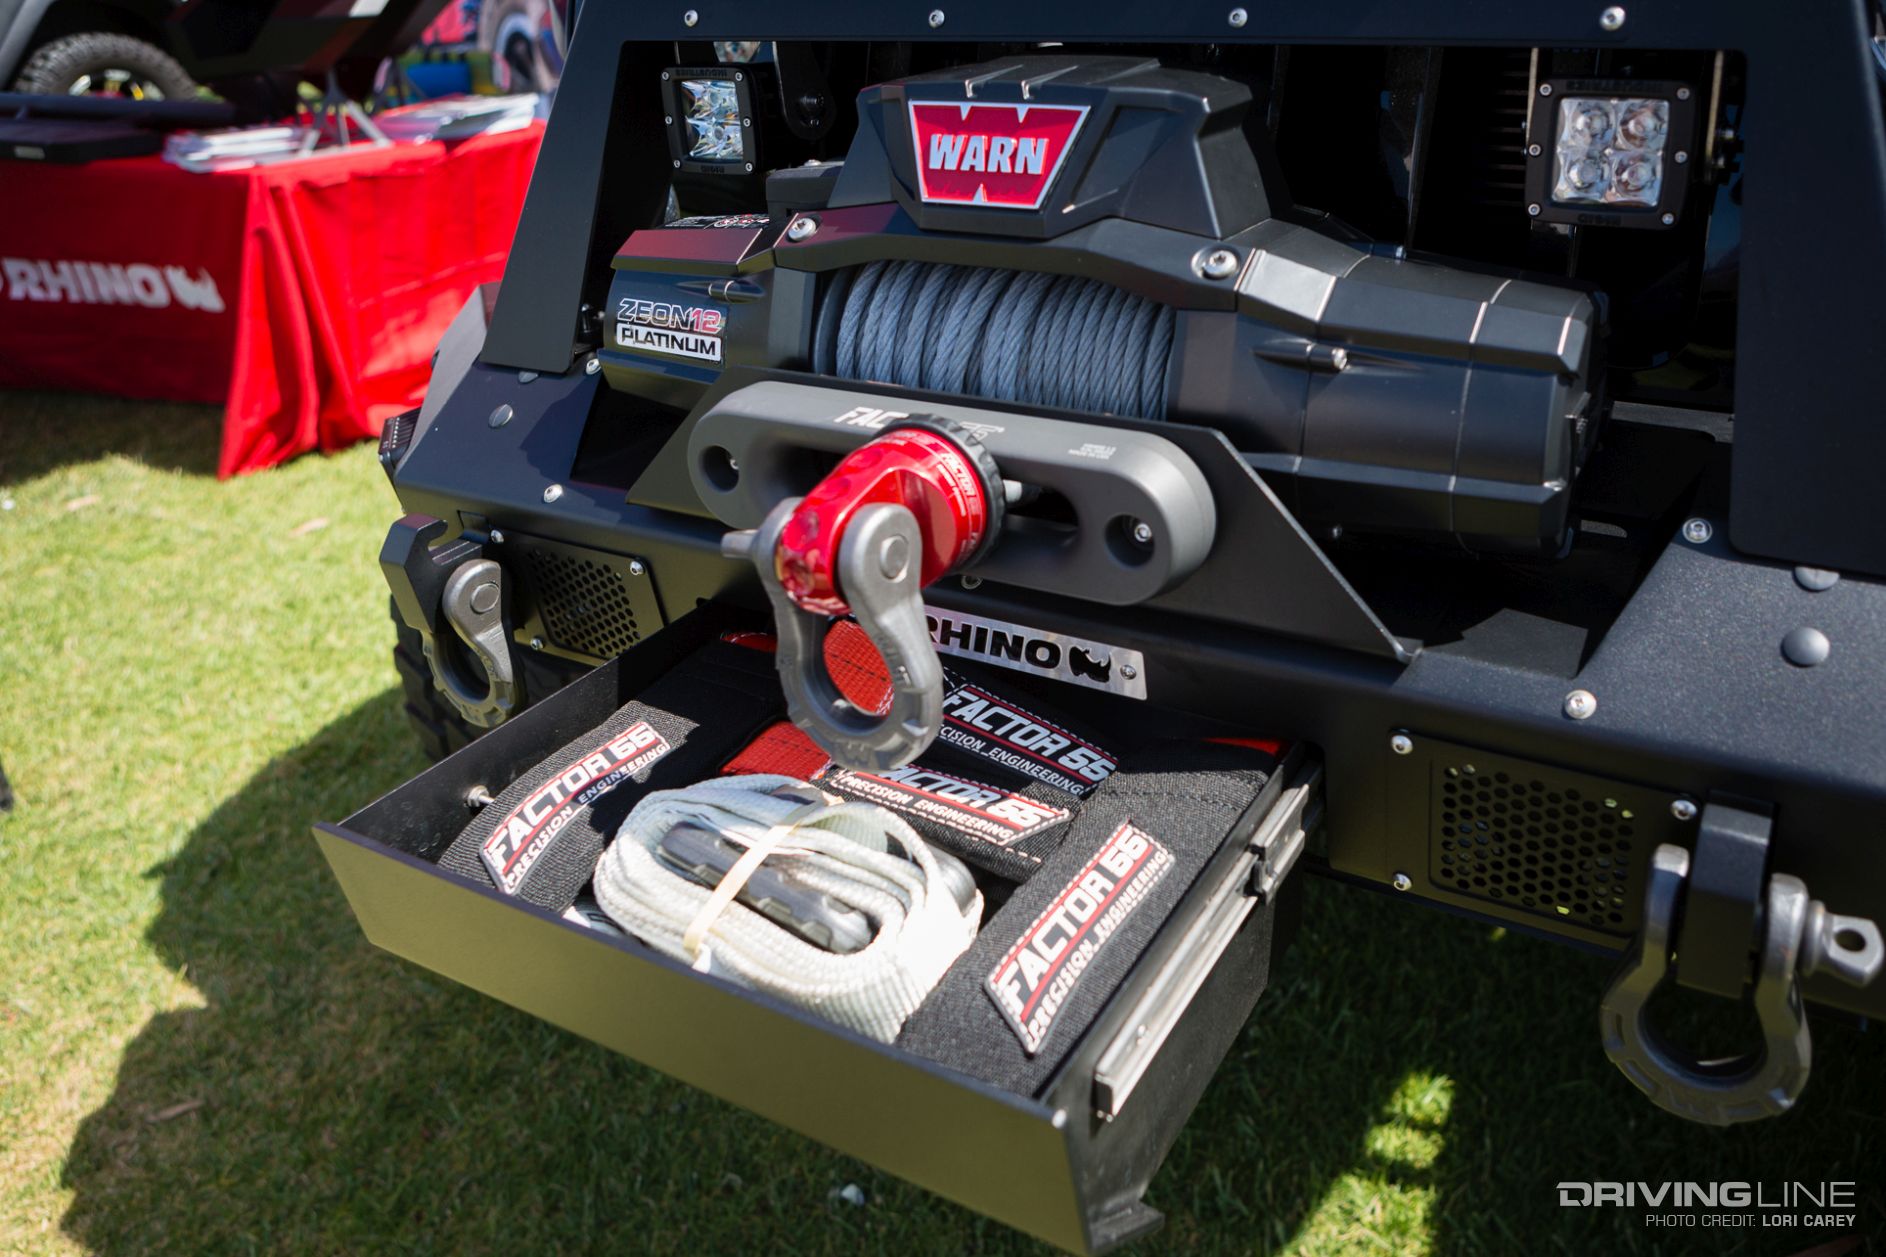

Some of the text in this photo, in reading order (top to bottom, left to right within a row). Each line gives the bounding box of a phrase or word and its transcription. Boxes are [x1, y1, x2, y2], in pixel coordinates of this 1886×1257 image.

[929, 134, 1049, 174] WARN
[2, 257, 170, 308] RHINO
[621, 328, 716, 356] PLATINUM
[834, 406, 909, 429] FAC
[940, 725, 1084, 796] CISION ENGINEERING
[942, 689, 1116, 782] FACTOR 55
[486, 725, 656, 872] FACTOR 55
[507, 744, 667, 886] PRECISION ENGINEERING
[841, 775, 1014, 840] PRECISION ENGINEERING
[878, 766, 1047, 828] ACTOR 55
[998, 828, 1149, 1017] FACTOR 55
[1028, 938, 1095, 1042] PRECISION
